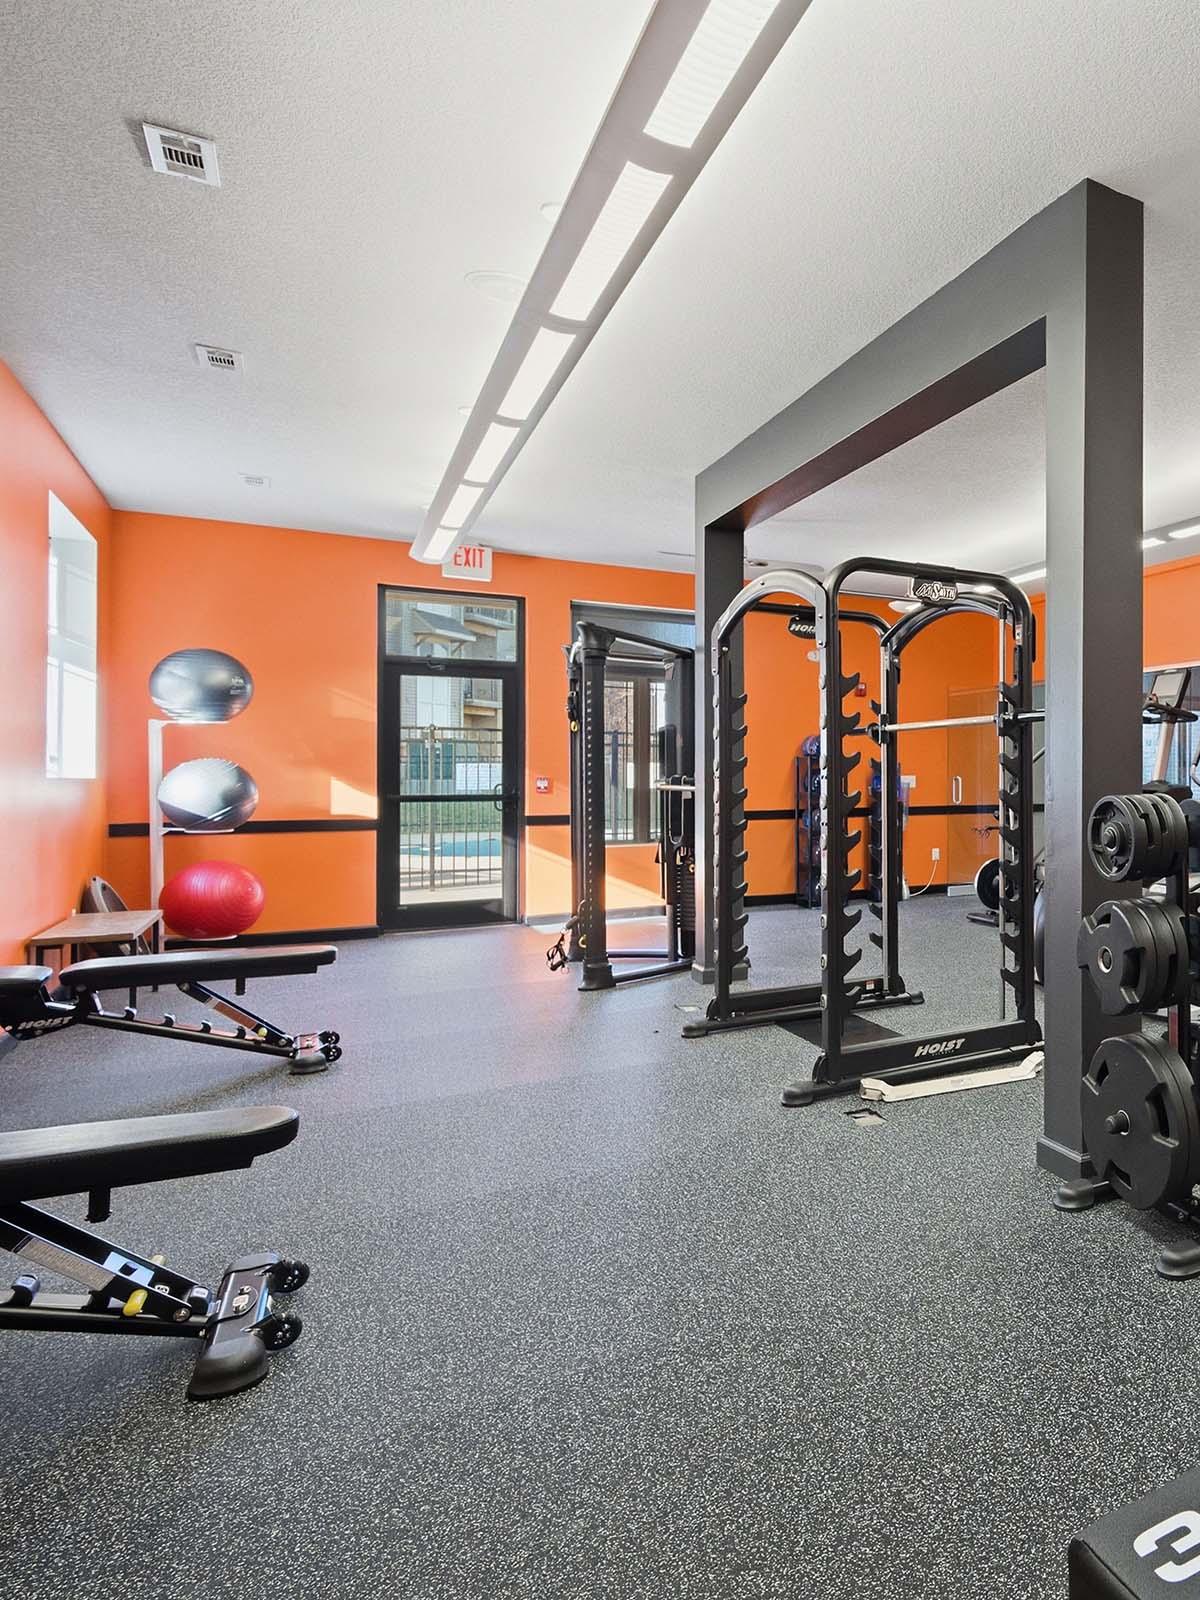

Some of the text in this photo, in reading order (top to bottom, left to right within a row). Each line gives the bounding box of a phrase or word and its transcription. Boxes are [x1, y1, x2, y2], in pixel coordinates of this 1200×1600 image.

[453, 545, 486, 569] EXIT
[789, 623, 817, 633] HOI
[914, 1038, 966, 1058] HOIST
